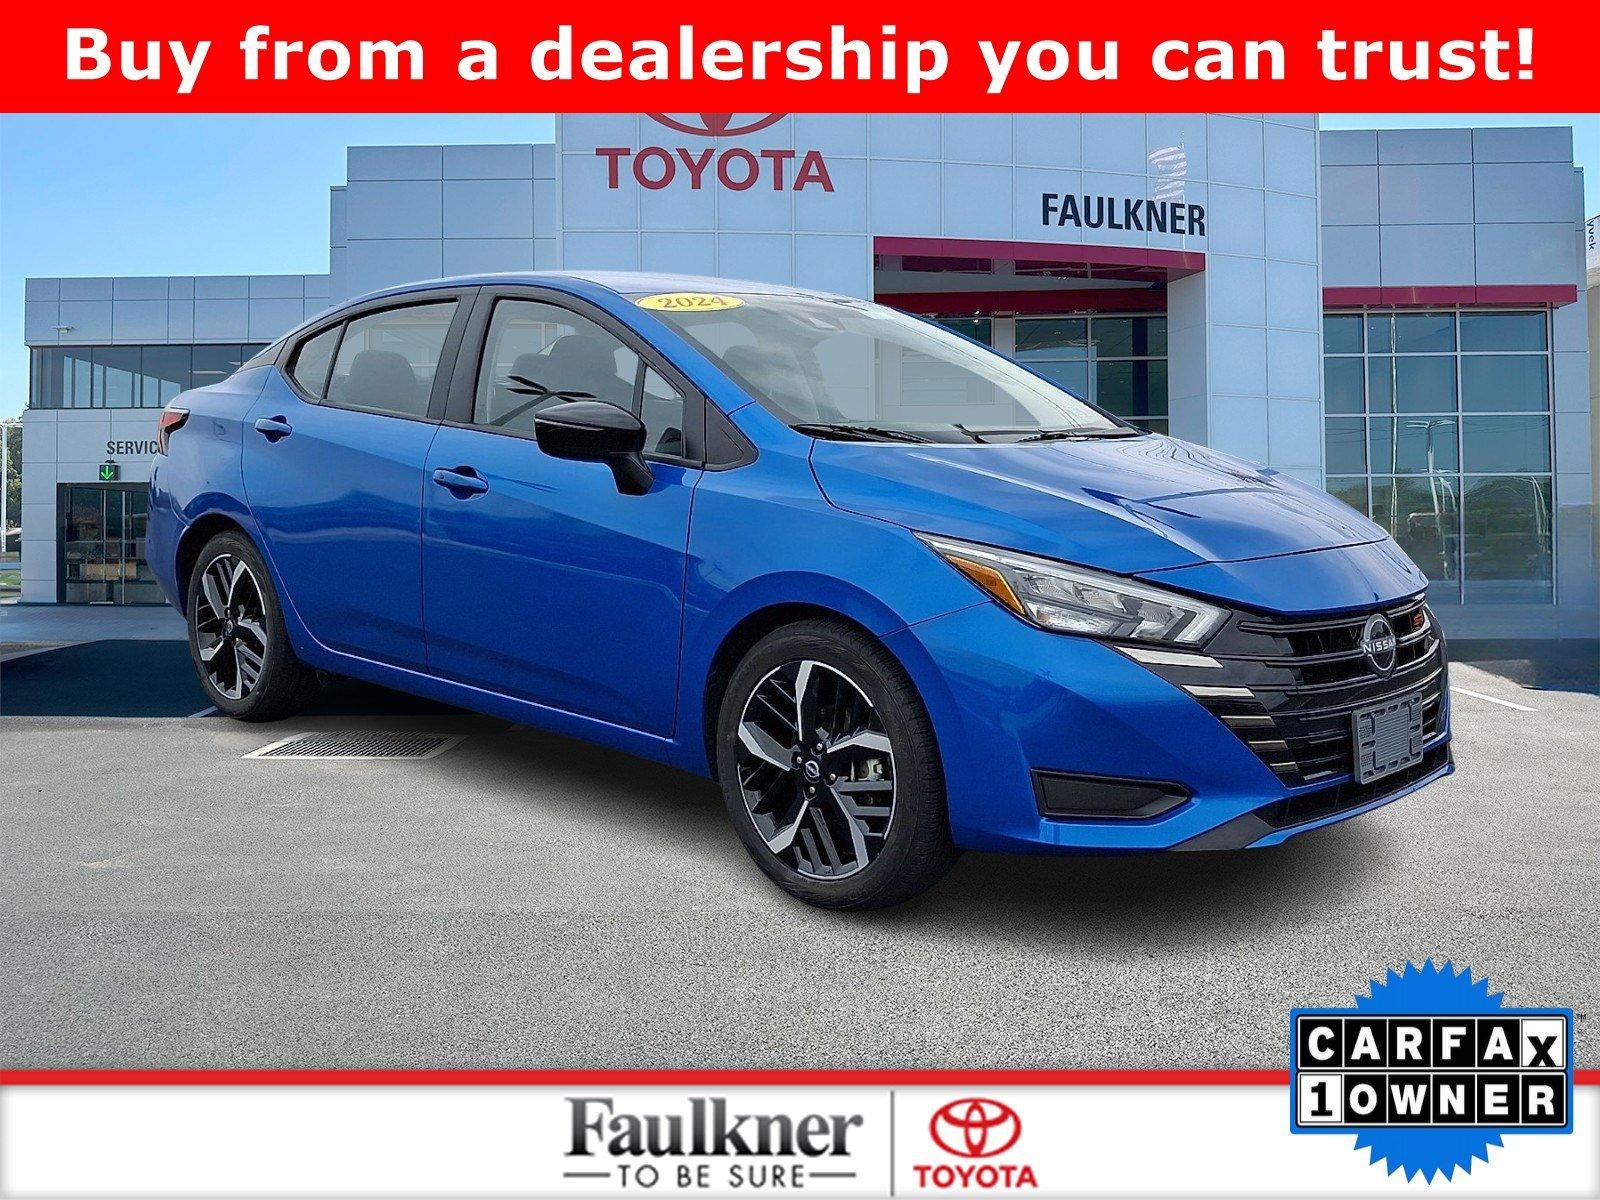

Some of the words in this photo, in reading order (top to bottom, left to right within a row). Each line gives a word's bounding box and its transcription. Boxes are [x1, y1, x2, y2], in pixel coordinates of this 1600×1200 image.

[595, 147, 835, 192] TOYOTA
[1042, 193, 1206, 237] FAULKNER
[1587, 219, 1597, 251] yvek
[657, 296, 728, 309] 2024
[106, 440, 159, 455] SERVIC
